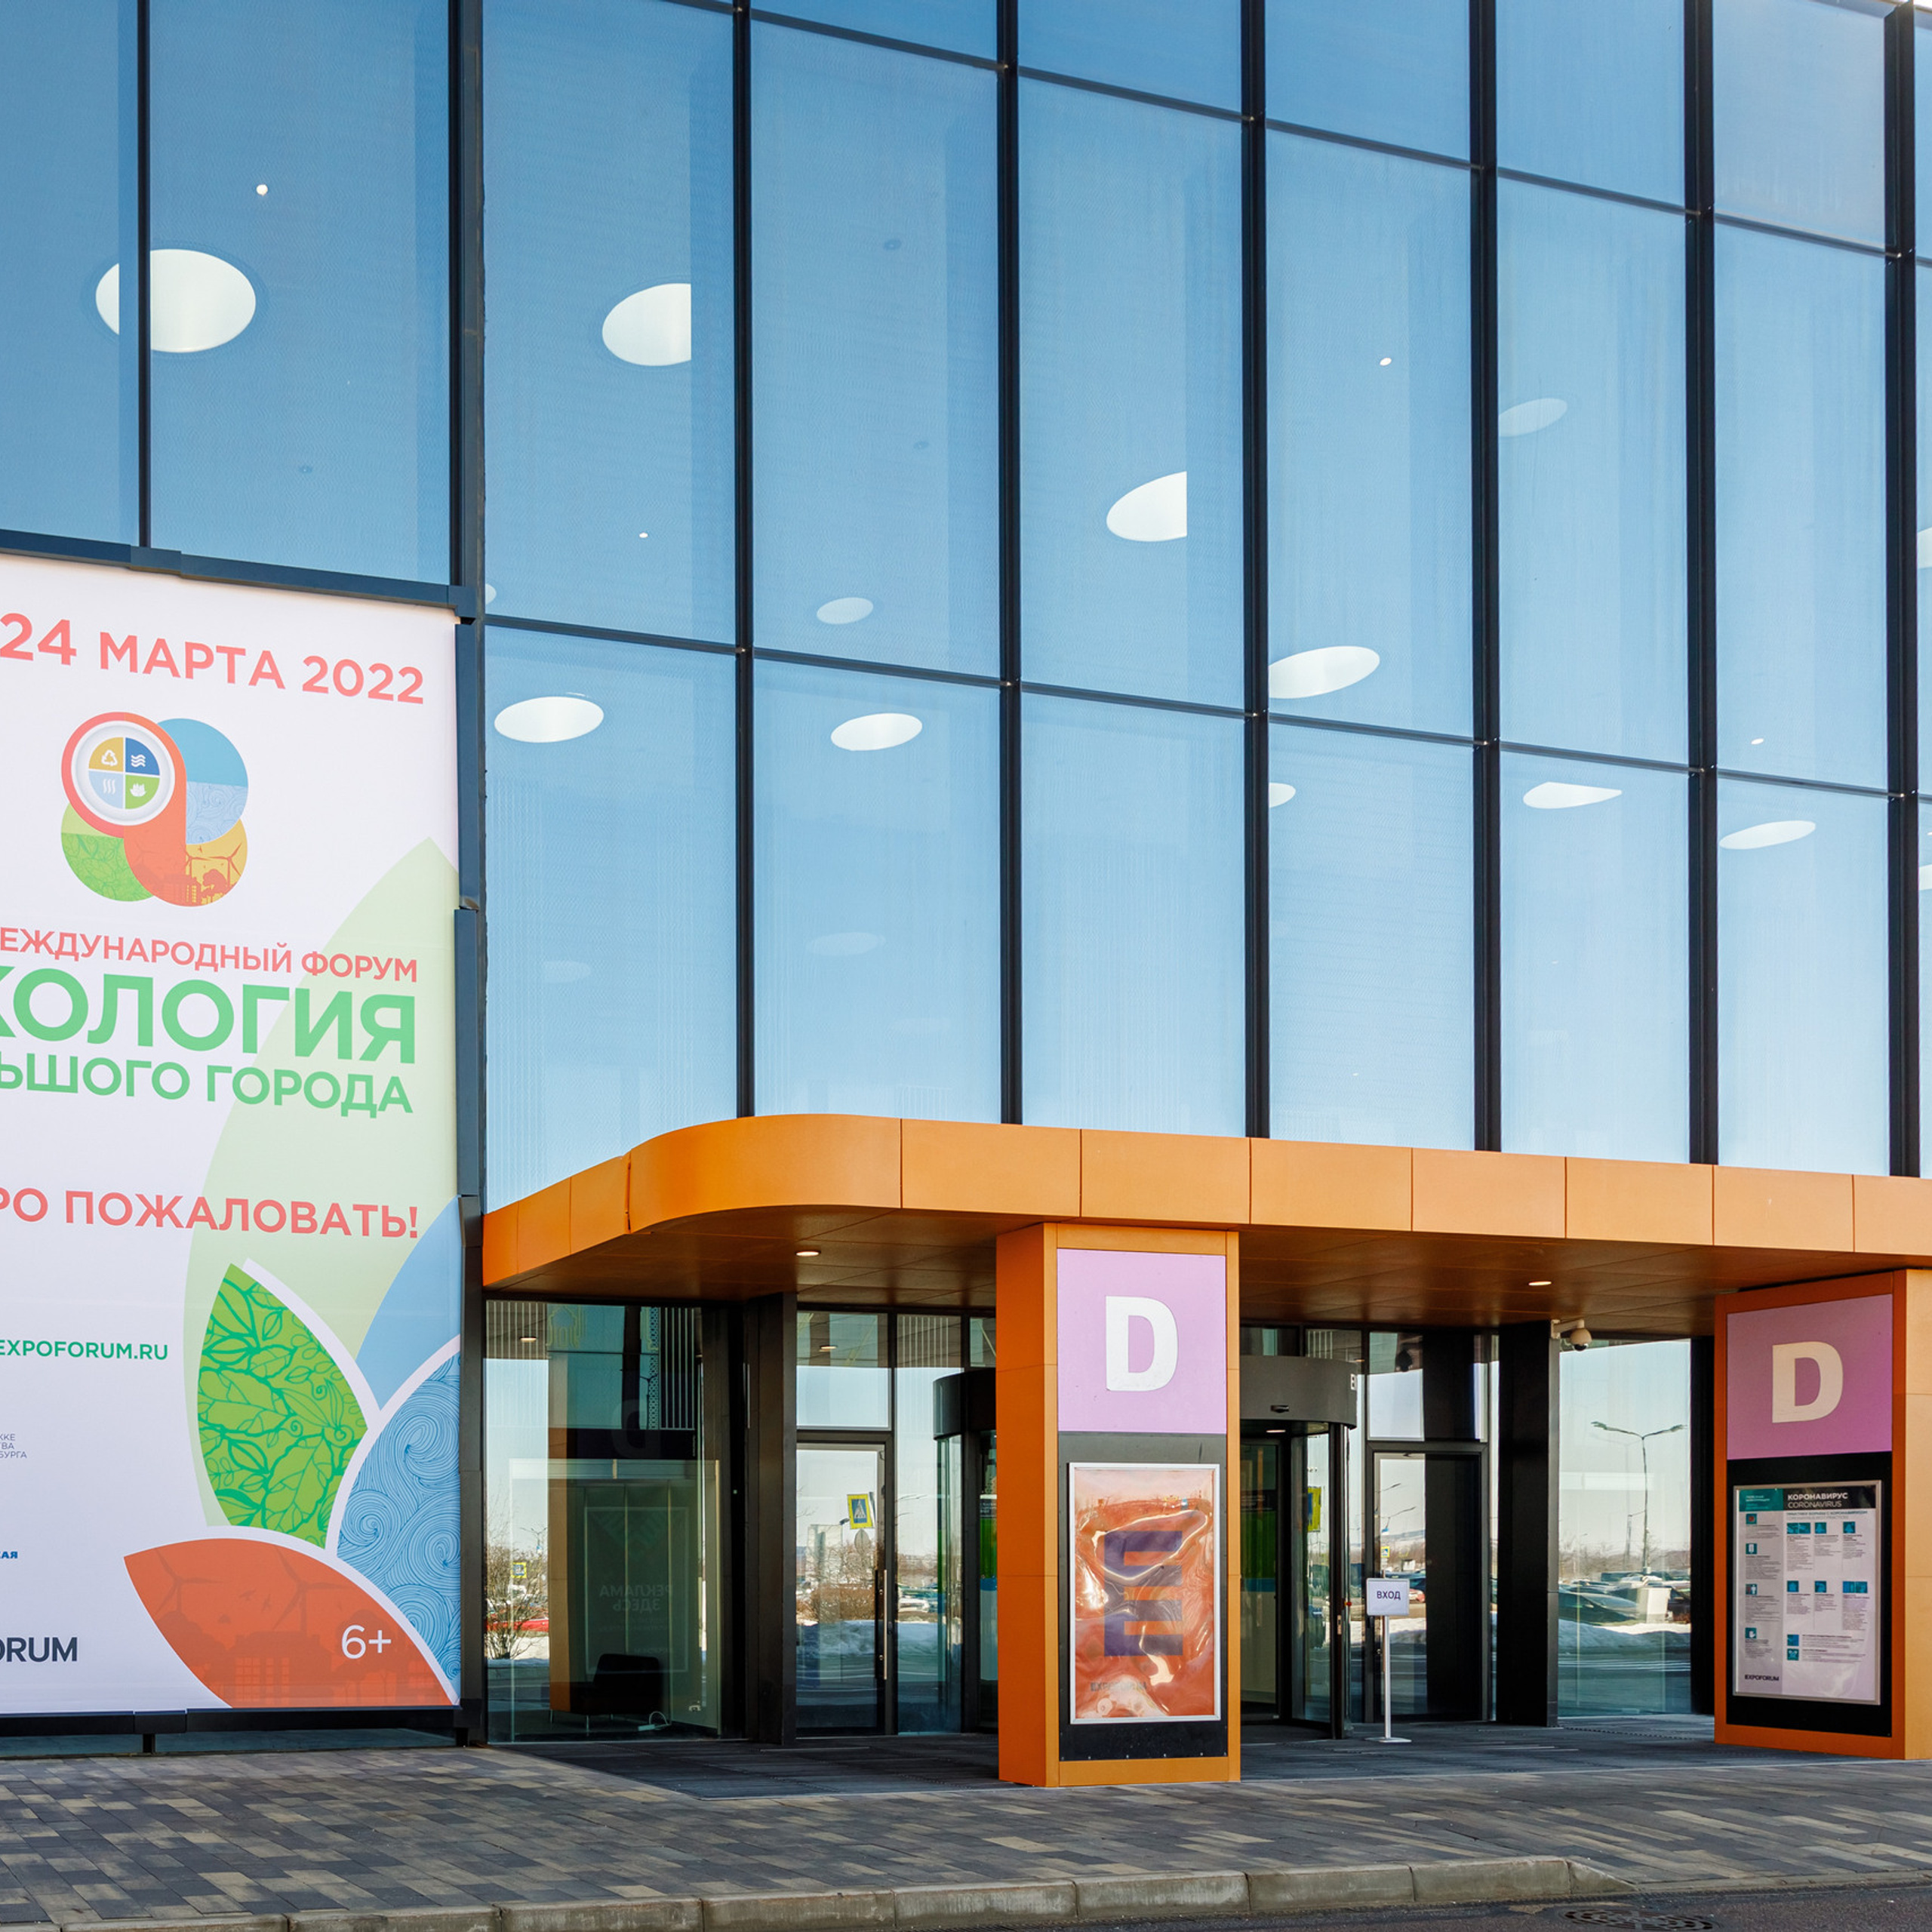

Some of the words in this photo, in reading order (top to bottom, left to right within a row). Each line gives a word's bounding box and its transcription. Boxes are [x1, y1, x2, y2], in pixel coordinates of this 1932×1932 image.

[0, 613, 76, 666] 24
[100, 632, 285, 688] МАРТА
[302, 656, 423, 705] 2022
[302, 951, 417, 983] ФОРУМ
[0, 965, 416, 1064] ОЛОГИЯ
[207, 1064, 414, 1118] ГОРОДА
[66, 1190, 418, 1238] ПОЖАЛОВАТЬ!
[1105, 1295, 1178, 1392] D
[1772, 1341, 1844, 1423] D
[1787, 1492, 1848, 1501] КОРОНАВИРУС
[1787, 1500, 1842, 1509] CORONAVIRUS
[0, 1551, 18, 1559] АЯ
[1377, 1591, 1401, 1600] ВХОД
[0, 1636, 78, 1663] RUM
[342, 1624, 392, 1660] 6+
